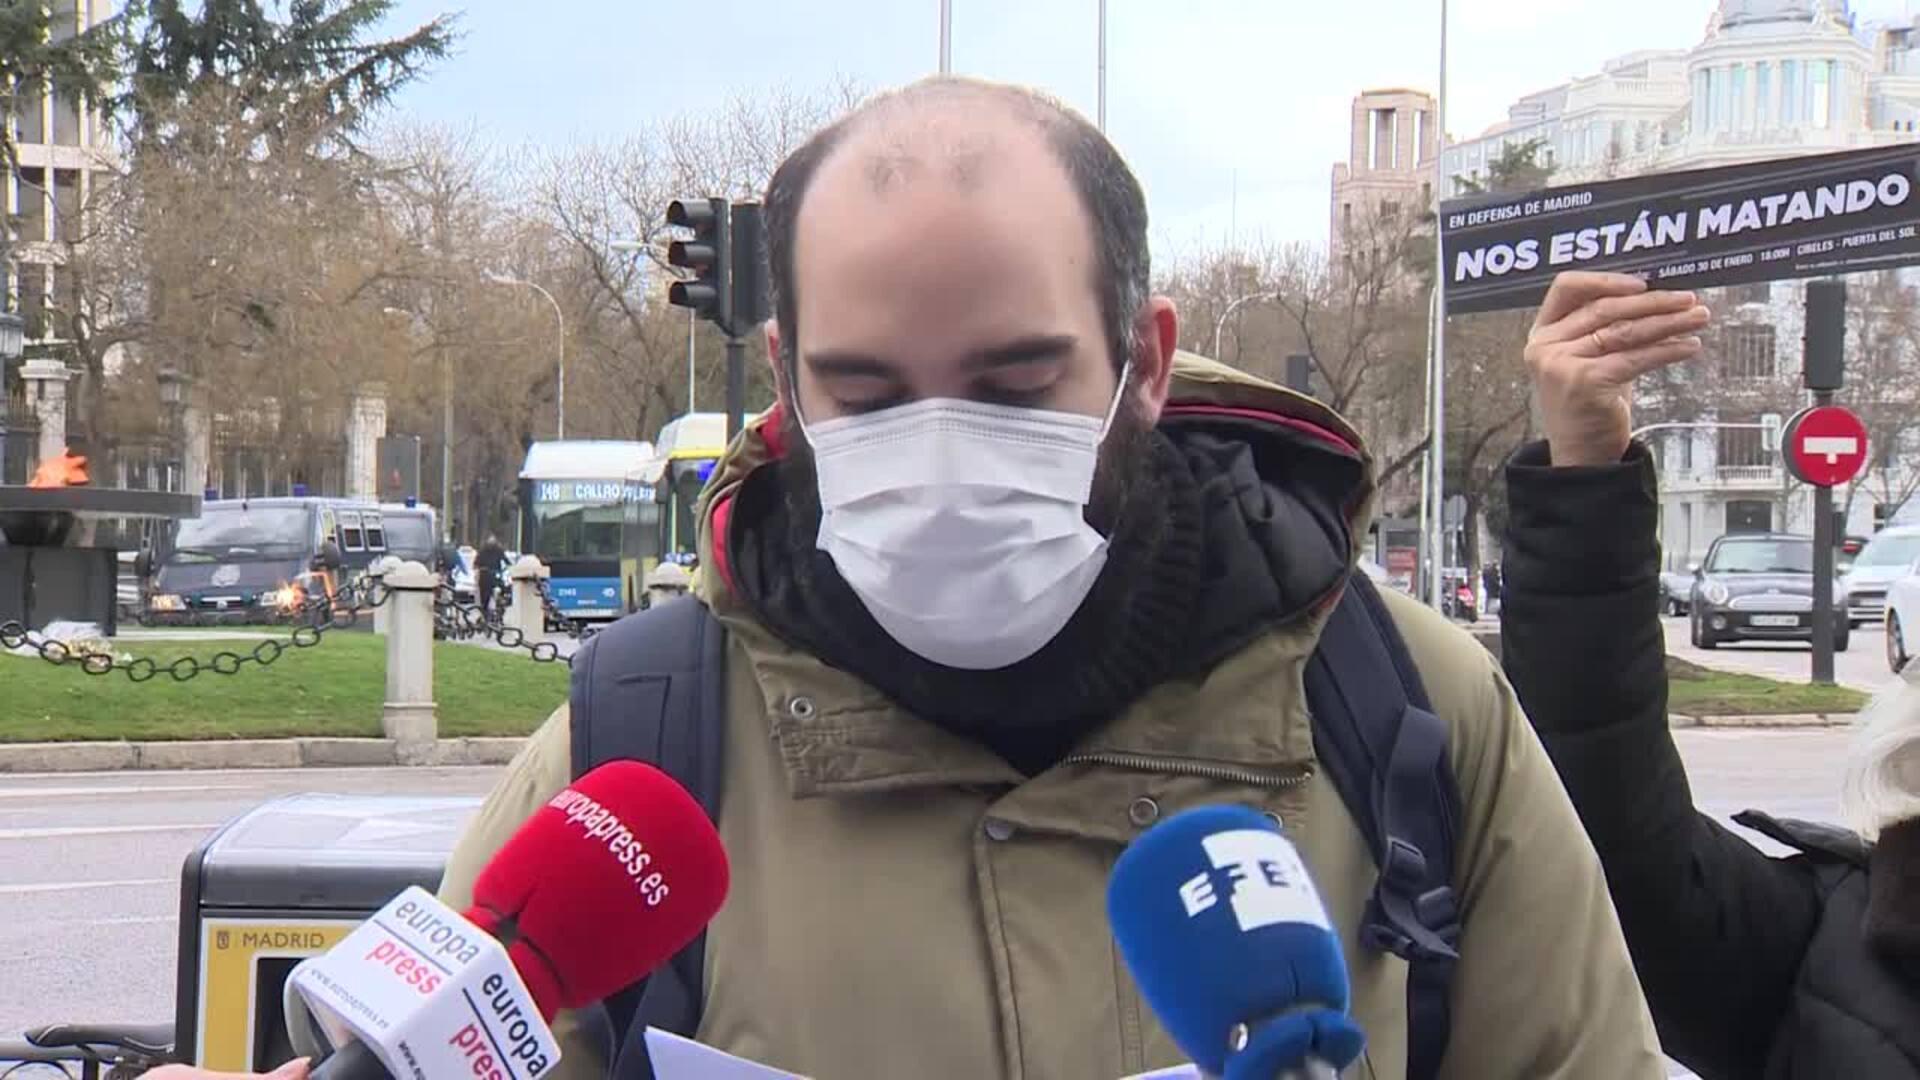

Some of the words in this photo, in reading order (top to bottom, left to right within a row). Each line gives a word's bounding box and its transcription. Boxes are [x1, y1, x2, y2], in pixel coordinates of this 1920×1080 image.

[1449, 215, 1465, 229] EN
[1468, 203, 1522, 225] DEFENSA
[1524, 200, 1541, 214] DE
[1543, 191, 1593, 212] MADRID
[1455, 239, 1539, 282] NOS
[1550, 210, 1687, 265] ESTÁN
[1697, 173, 1911, 239] MATANDO
[1697, 261, 1709, 273] 30
[1710, 258, 1722, 270] DE
[1724, 253, 1753, 268] ENERO
[1797, 240, 1834, 256] CIBELES
[1842, 234, 1877, 249] PUERTA
[1879, 230, 1896, 242] DEL
[1898, 226, 1916, 239] SOL
[242, 932, 324, 948] MADRID
[394, 900, 480, 966] europa
[364, 939, 443, 996] press
[481, 972, 549, 1078] europa
